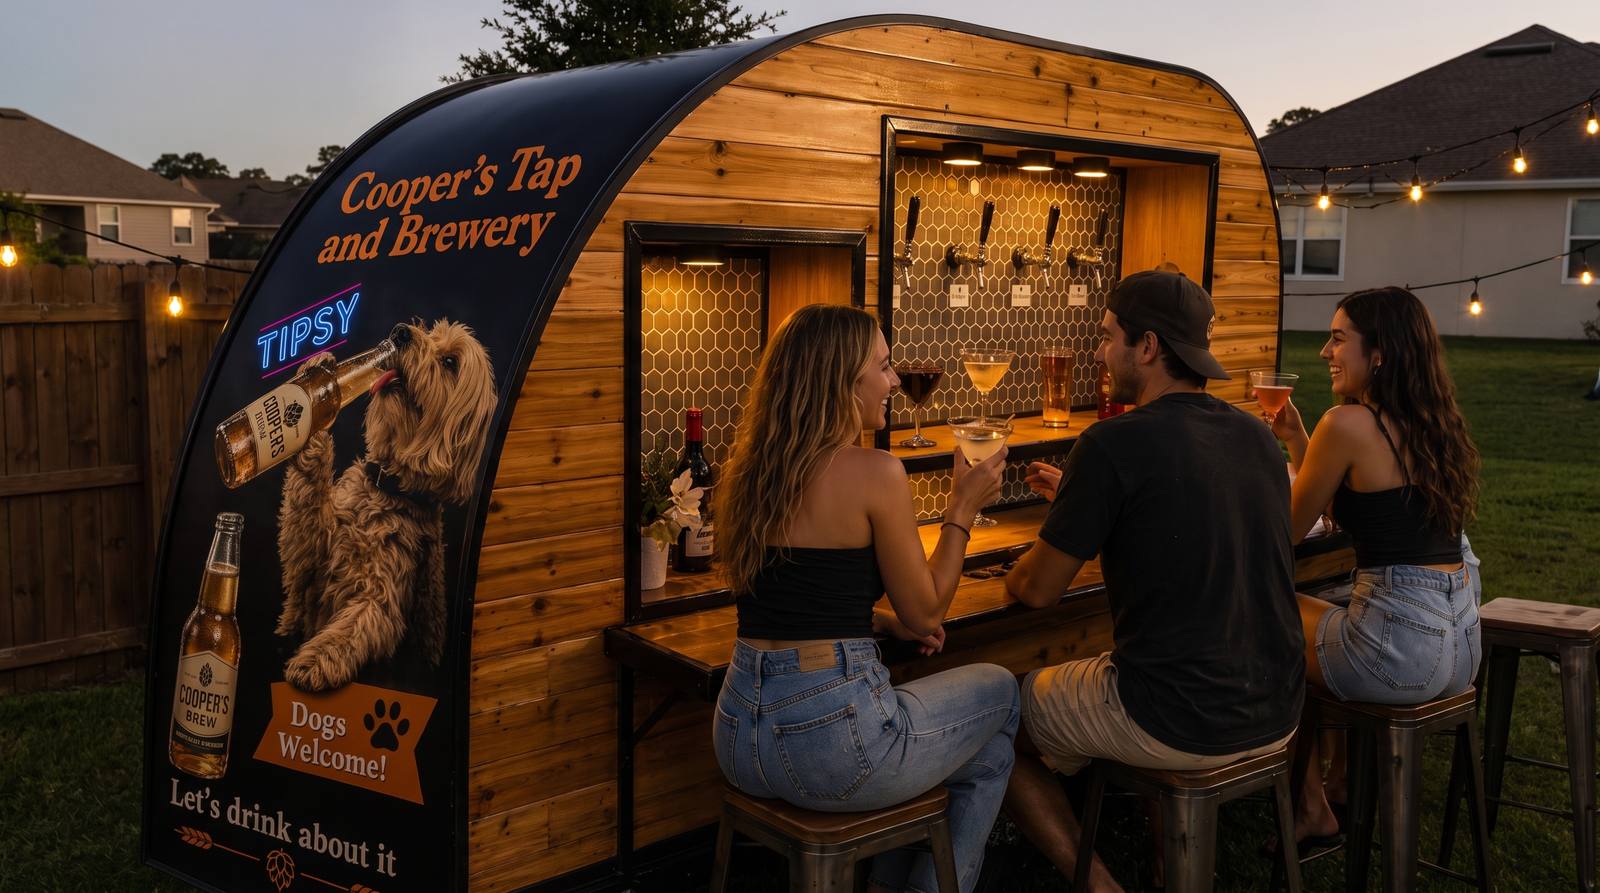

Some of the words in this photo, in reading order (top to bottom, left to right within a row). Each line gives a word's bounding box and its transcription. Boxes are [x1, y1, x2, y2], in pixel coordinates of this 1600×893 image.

[340, 154, 498, 215] Cooper's
[507, 145, 583, 199] Tap
[317, 217, 390, 265] and
[388, 211, 556, 257] Brewery
[257, 292, 361, 369] TIPSY
[263, 395, 285, 459] COOPERS
[179, 684, 230, 715] COOPER'S
[186, 710, 218, 729] BREW
[290, 701, 347, 741] Dogs
[277, 731, 387, 782] Welcome!
[169, 777, 220, 819] Let's
[226, 796, 292, 843] drink
[298, 822, 370, 869] about
[376, 843, 397, 878] it
